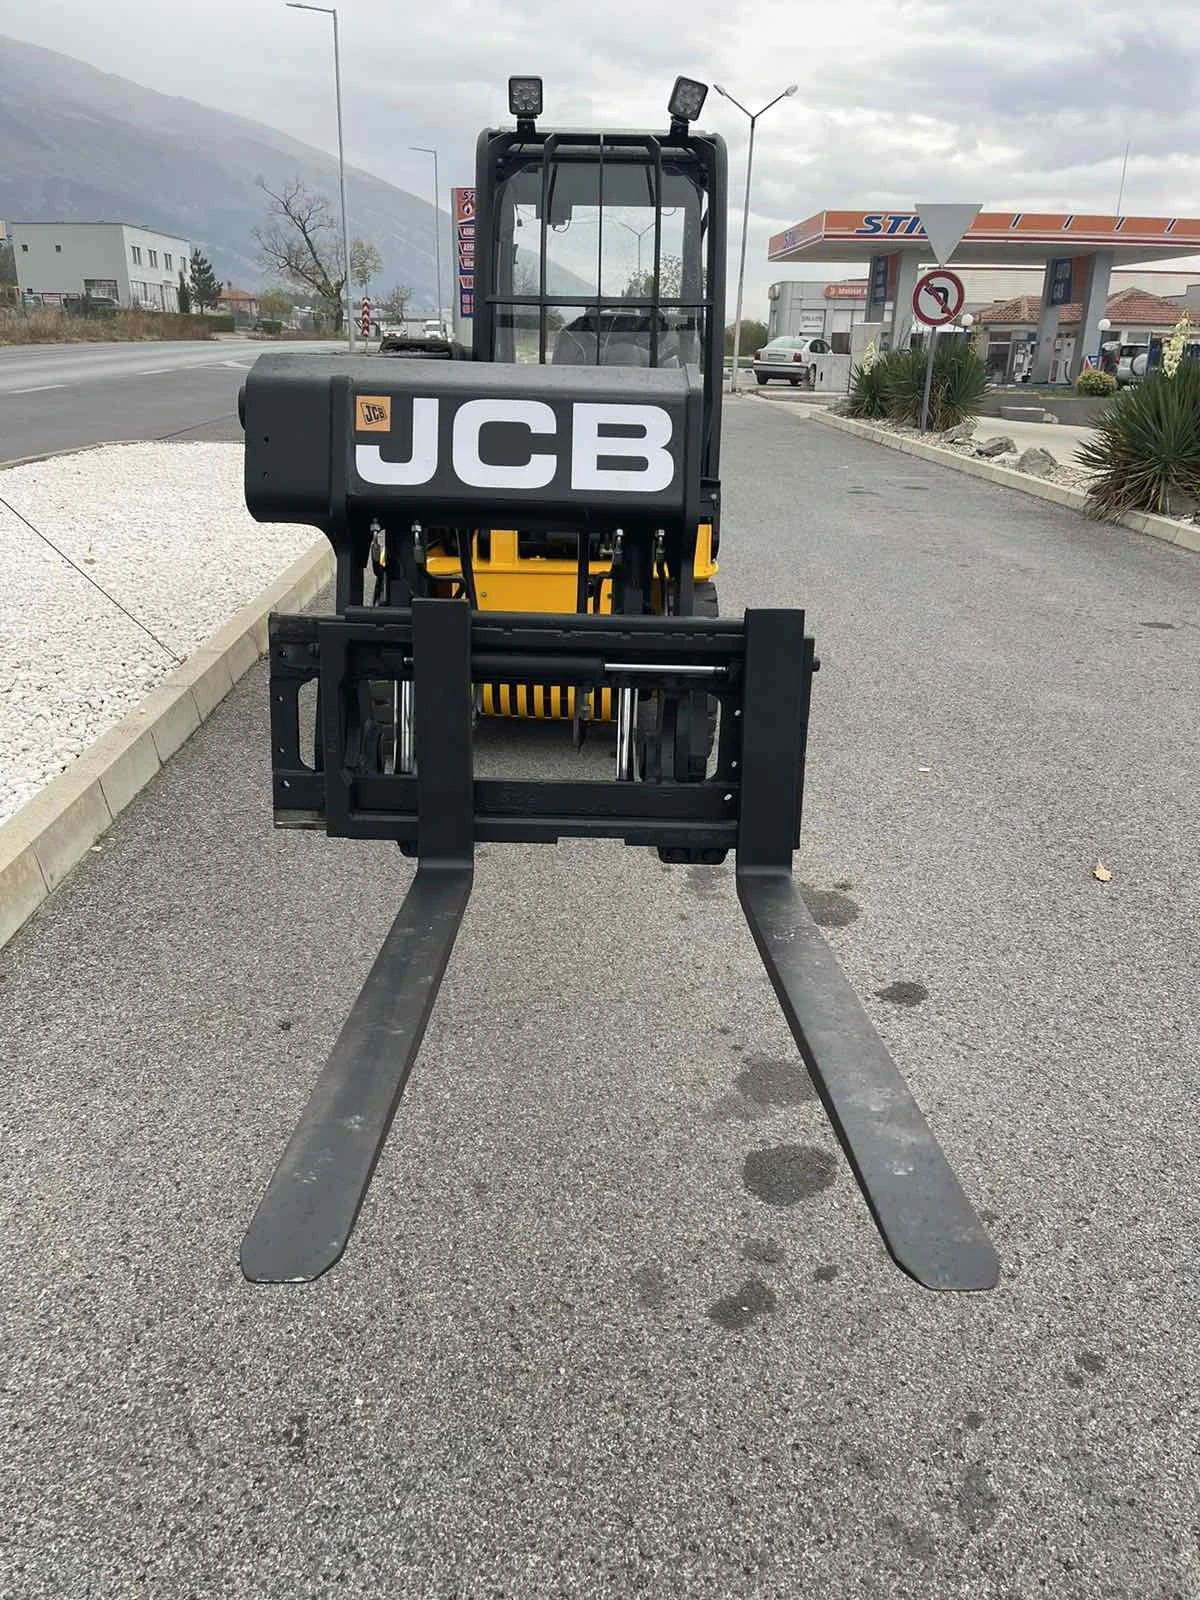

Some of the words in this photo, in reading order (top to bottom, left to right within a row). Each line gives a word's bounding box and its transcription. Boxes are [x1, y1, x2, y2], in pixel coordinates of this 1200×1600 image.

[855, 215, 928, 234] STI
[365, 404, 386, 422] JCB
[355, 397, 675, 492] JCB
